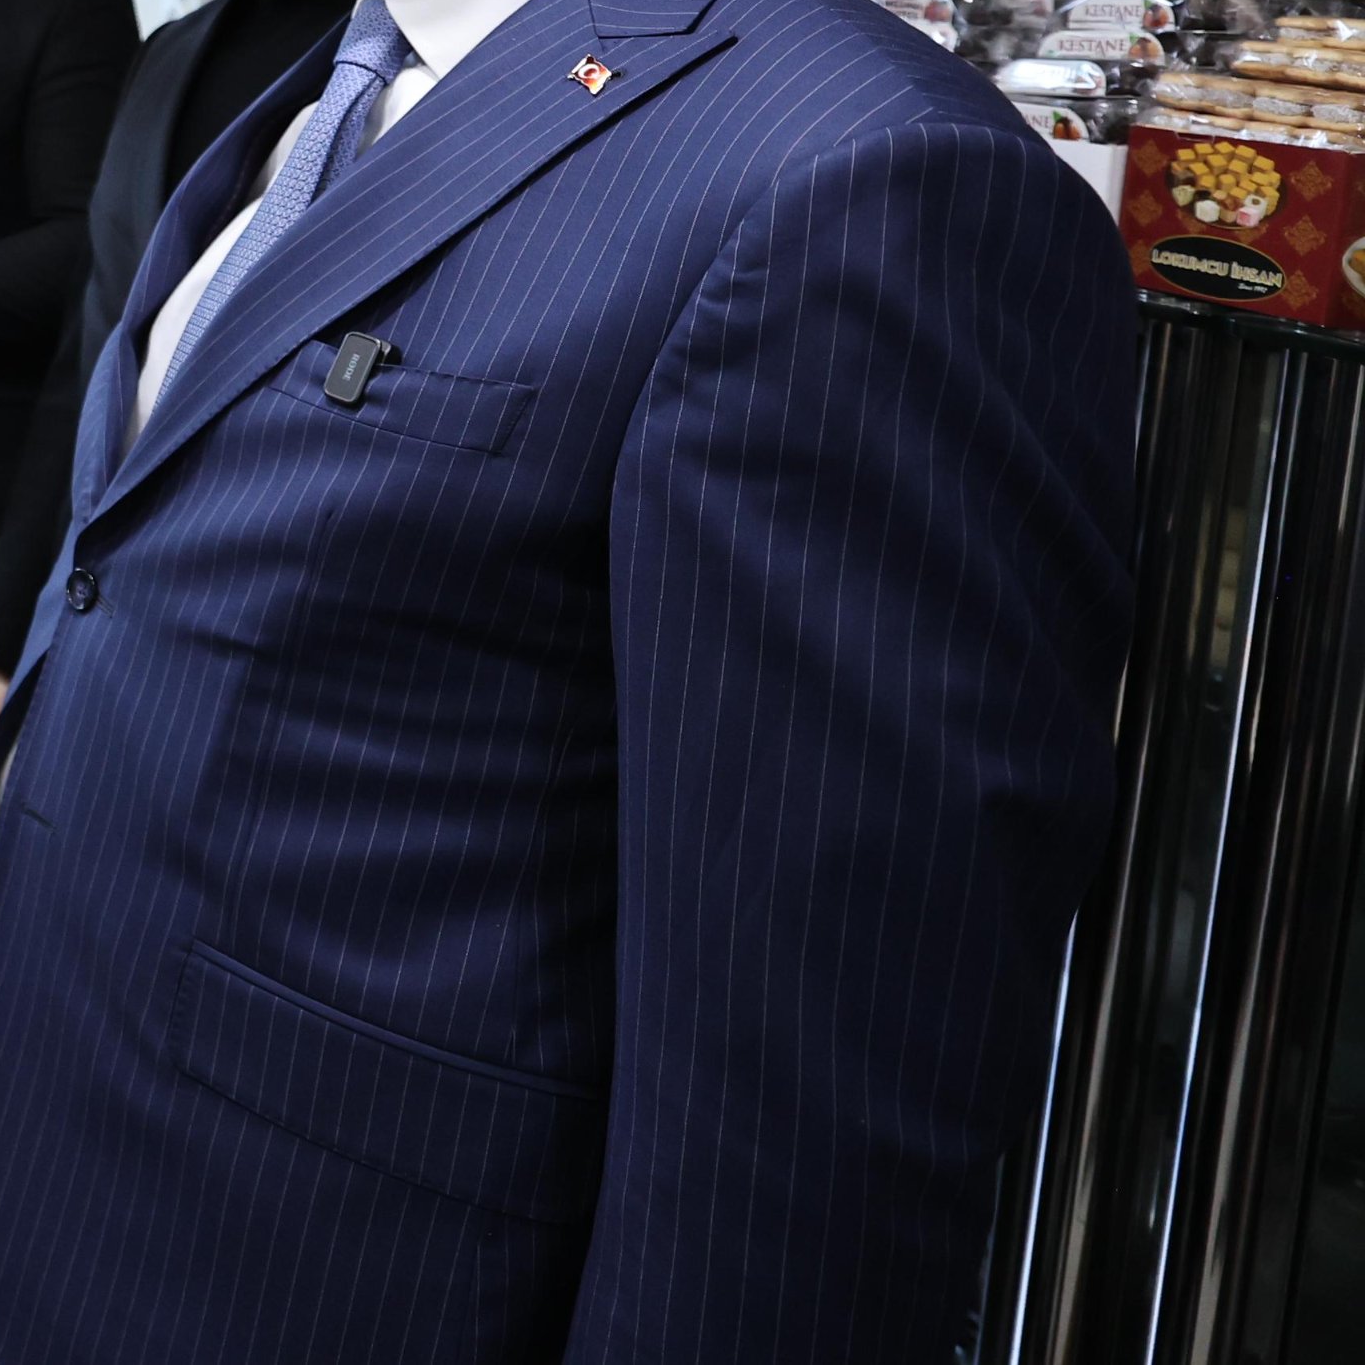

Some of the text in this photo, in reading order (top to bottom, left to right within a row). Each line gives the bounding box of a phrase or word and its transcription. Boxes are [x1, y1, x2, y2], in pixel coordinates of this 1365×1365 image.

[1085, 3, 1141, 22] KESTANE
[1059, 38, 1126, 55] KESTANE
[1152, 248, 1229, 277] LOKUMCU
